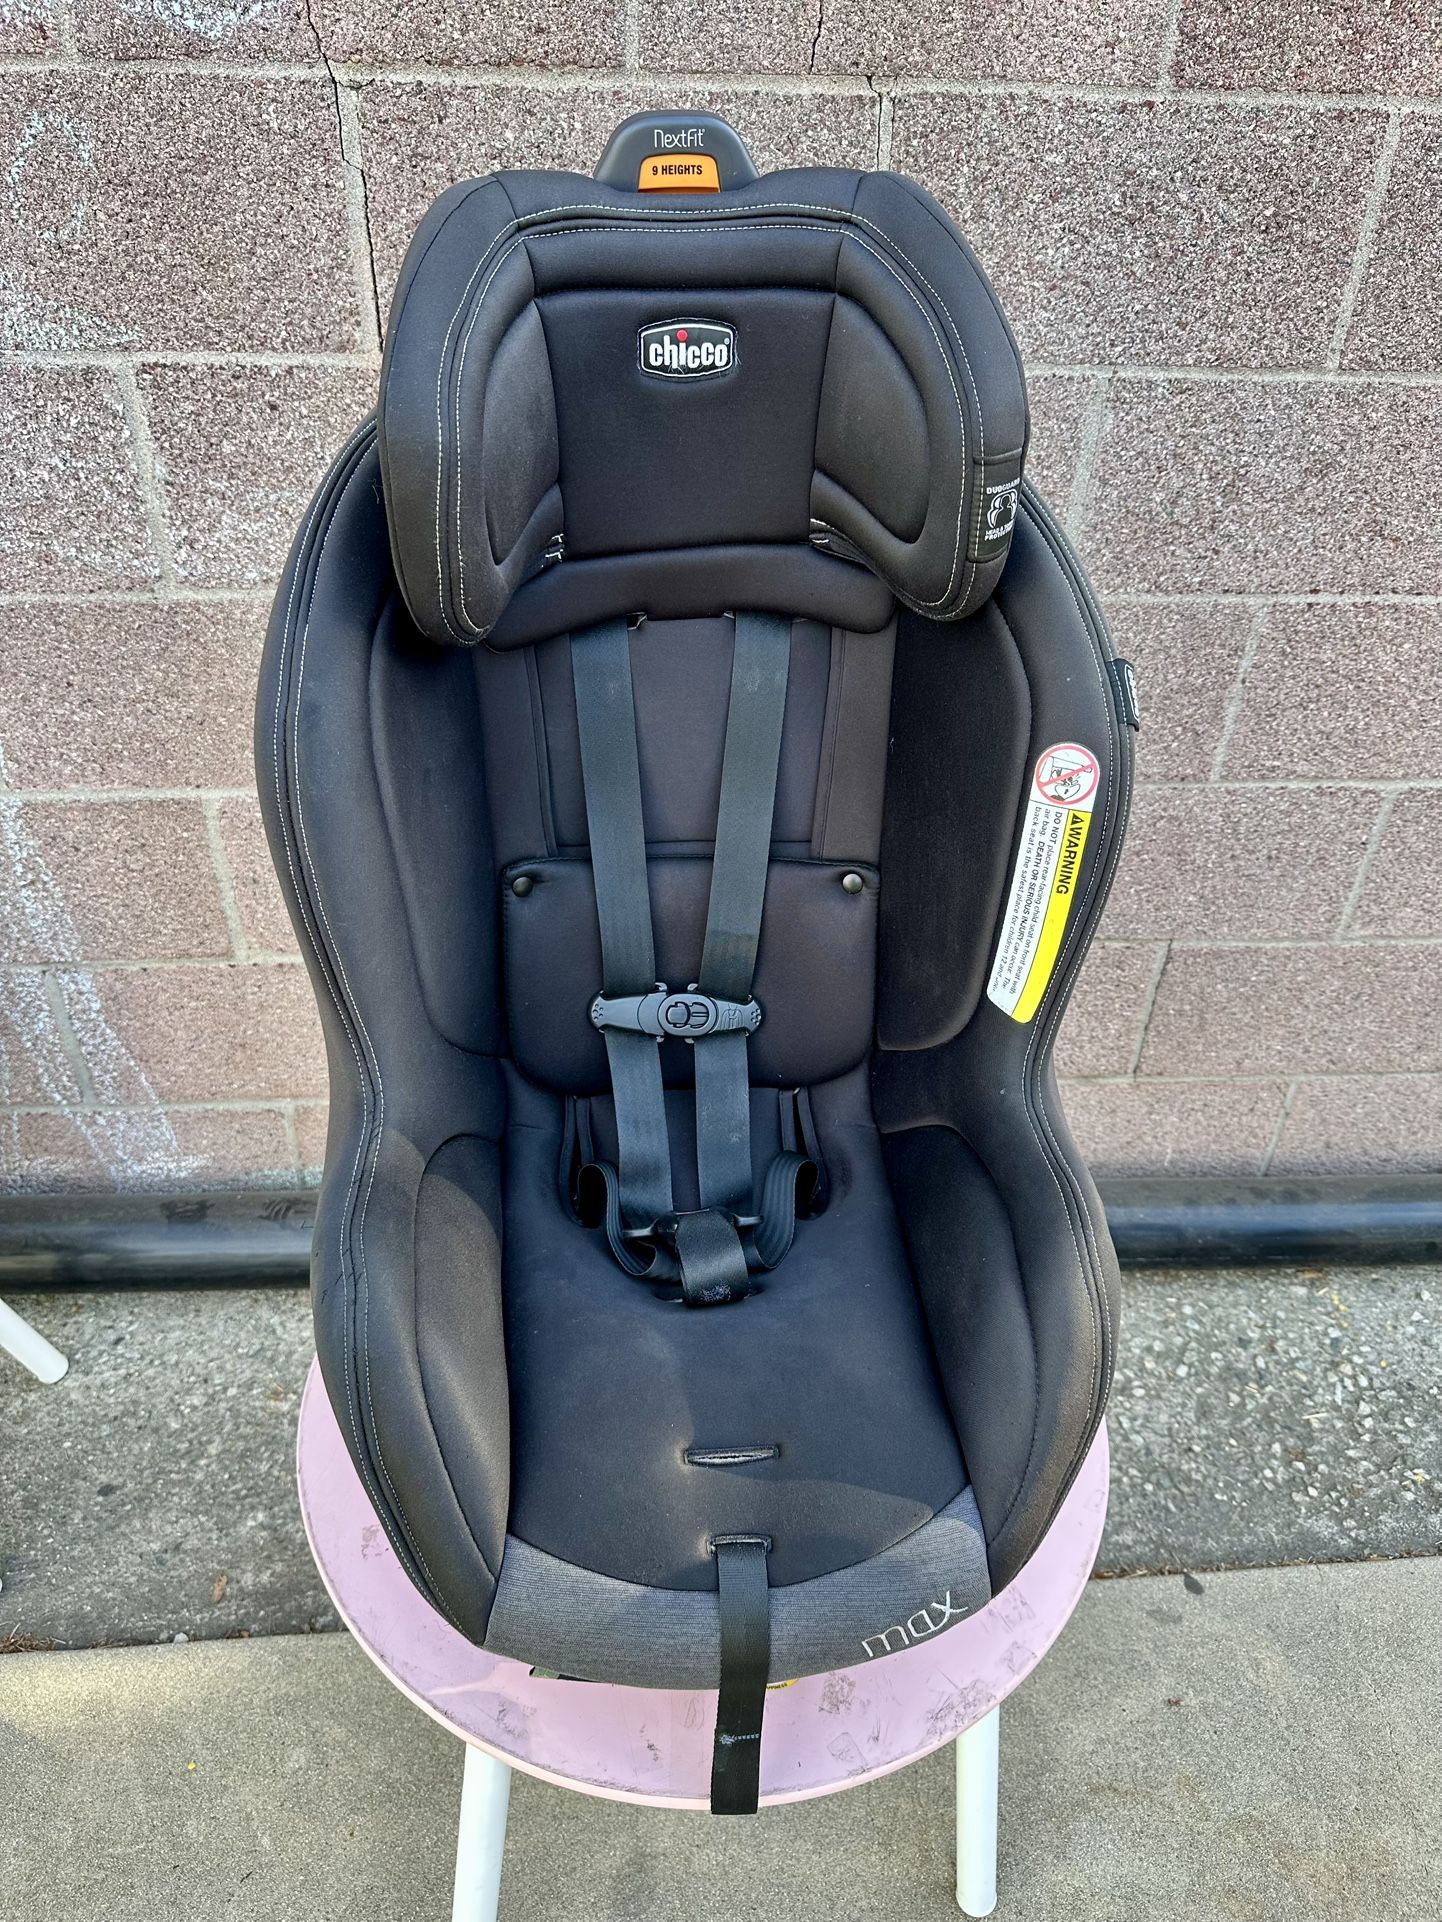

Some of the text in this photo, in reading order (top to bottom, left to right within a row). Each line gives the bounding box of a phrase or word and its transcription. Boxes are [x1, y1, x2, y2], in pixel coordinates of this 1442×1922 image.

[652, 164, 703, 175] 9 HEIGHTS
[649, 328, 728, 369] chicco
[1032, 806, 1042, 827] back
[1027, 828, 1037, 846] seat
[1022, 855, 1032, 869] the
[1033, 840, 1046, 868] DEATH
[1056, 827, 1083, 894] WARNING
[1017, 869, 1027, 893] safest
[1030, 868, 1039, 881] OR
[1009, 811, 1063, 995] DO NOT place rear-facing child seat on front seat with
[1013, 893, 1022, 914] place
[1022, 881, 1037, 916] SERIOUS
[1010, 914, 1019, 926] for
[1016, 915, 1029, 943] INJURY
[1004, 926, 1015, 954] children
[1001, 954, 1008, 965] 12
[861, 1590, 969, 1657] max
